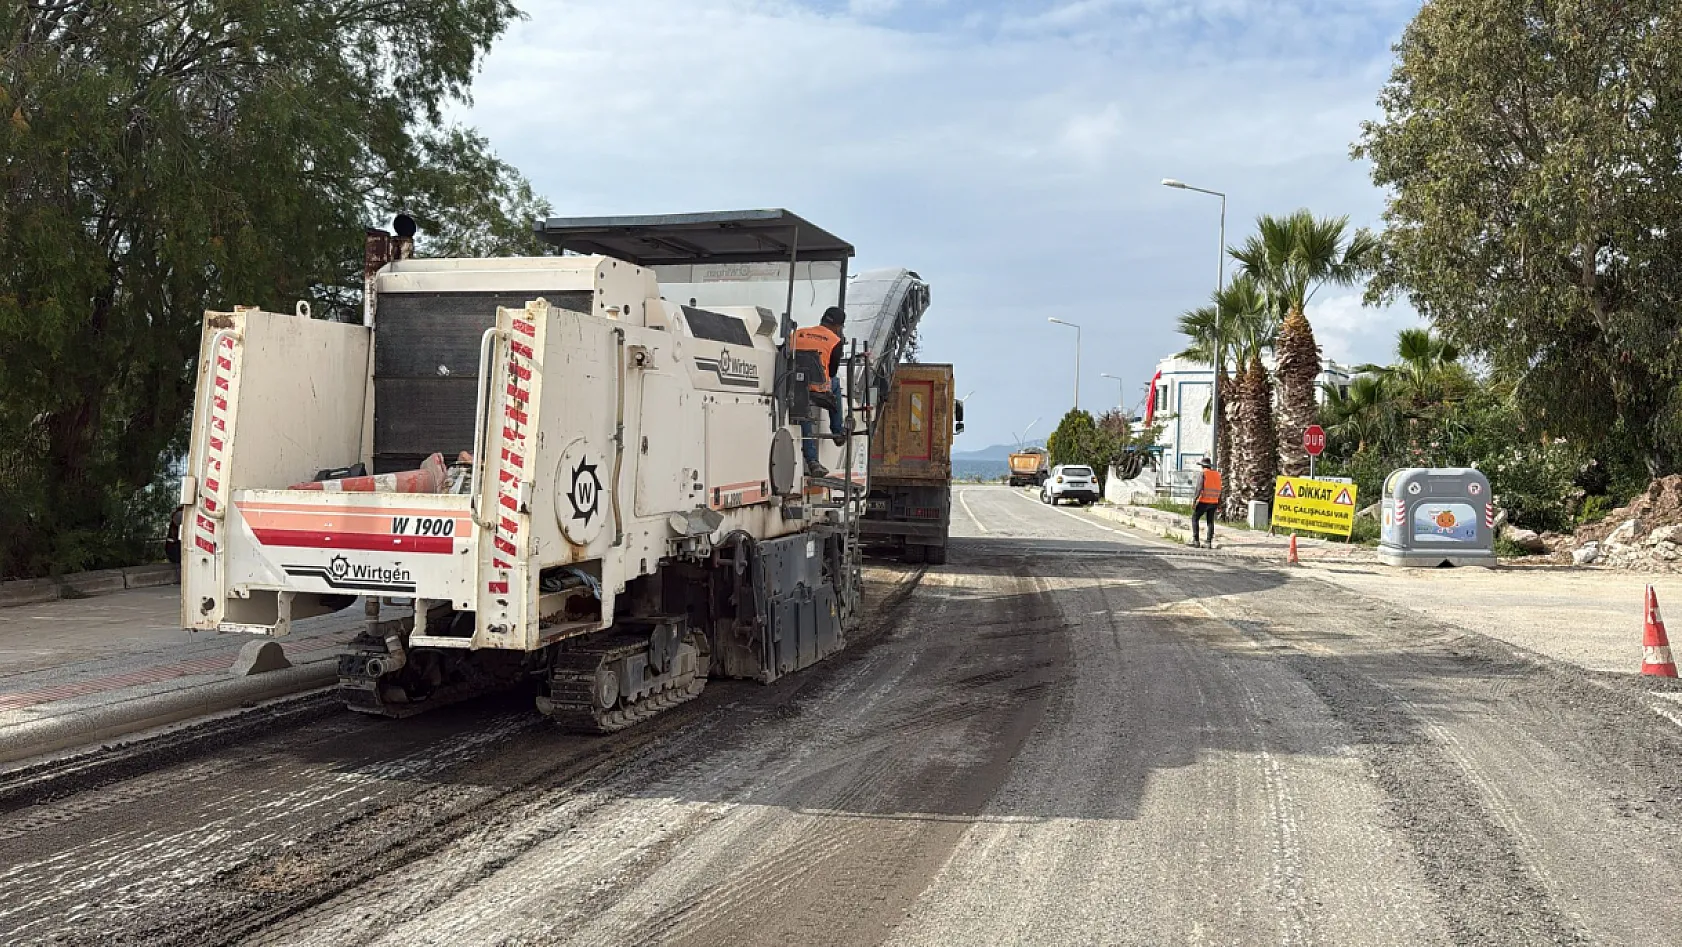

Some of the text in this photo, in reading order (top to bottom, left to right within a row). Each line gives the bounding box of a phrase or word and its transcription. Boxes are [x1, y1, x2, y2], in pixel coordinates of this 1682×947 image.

[731, 359, 758, 378] Wirtgen
[1304, 434, 1323, 446] DUR
[579, 482, 592, 504] W
[1298, 483, 1333, 500] DİKKAT
[1278, 503, 1349, 519] YOL ÇALIŞMASI VAR
[392, 517, 454, 536] W 1900
[352, 564, 410, 583] Wirtgen
